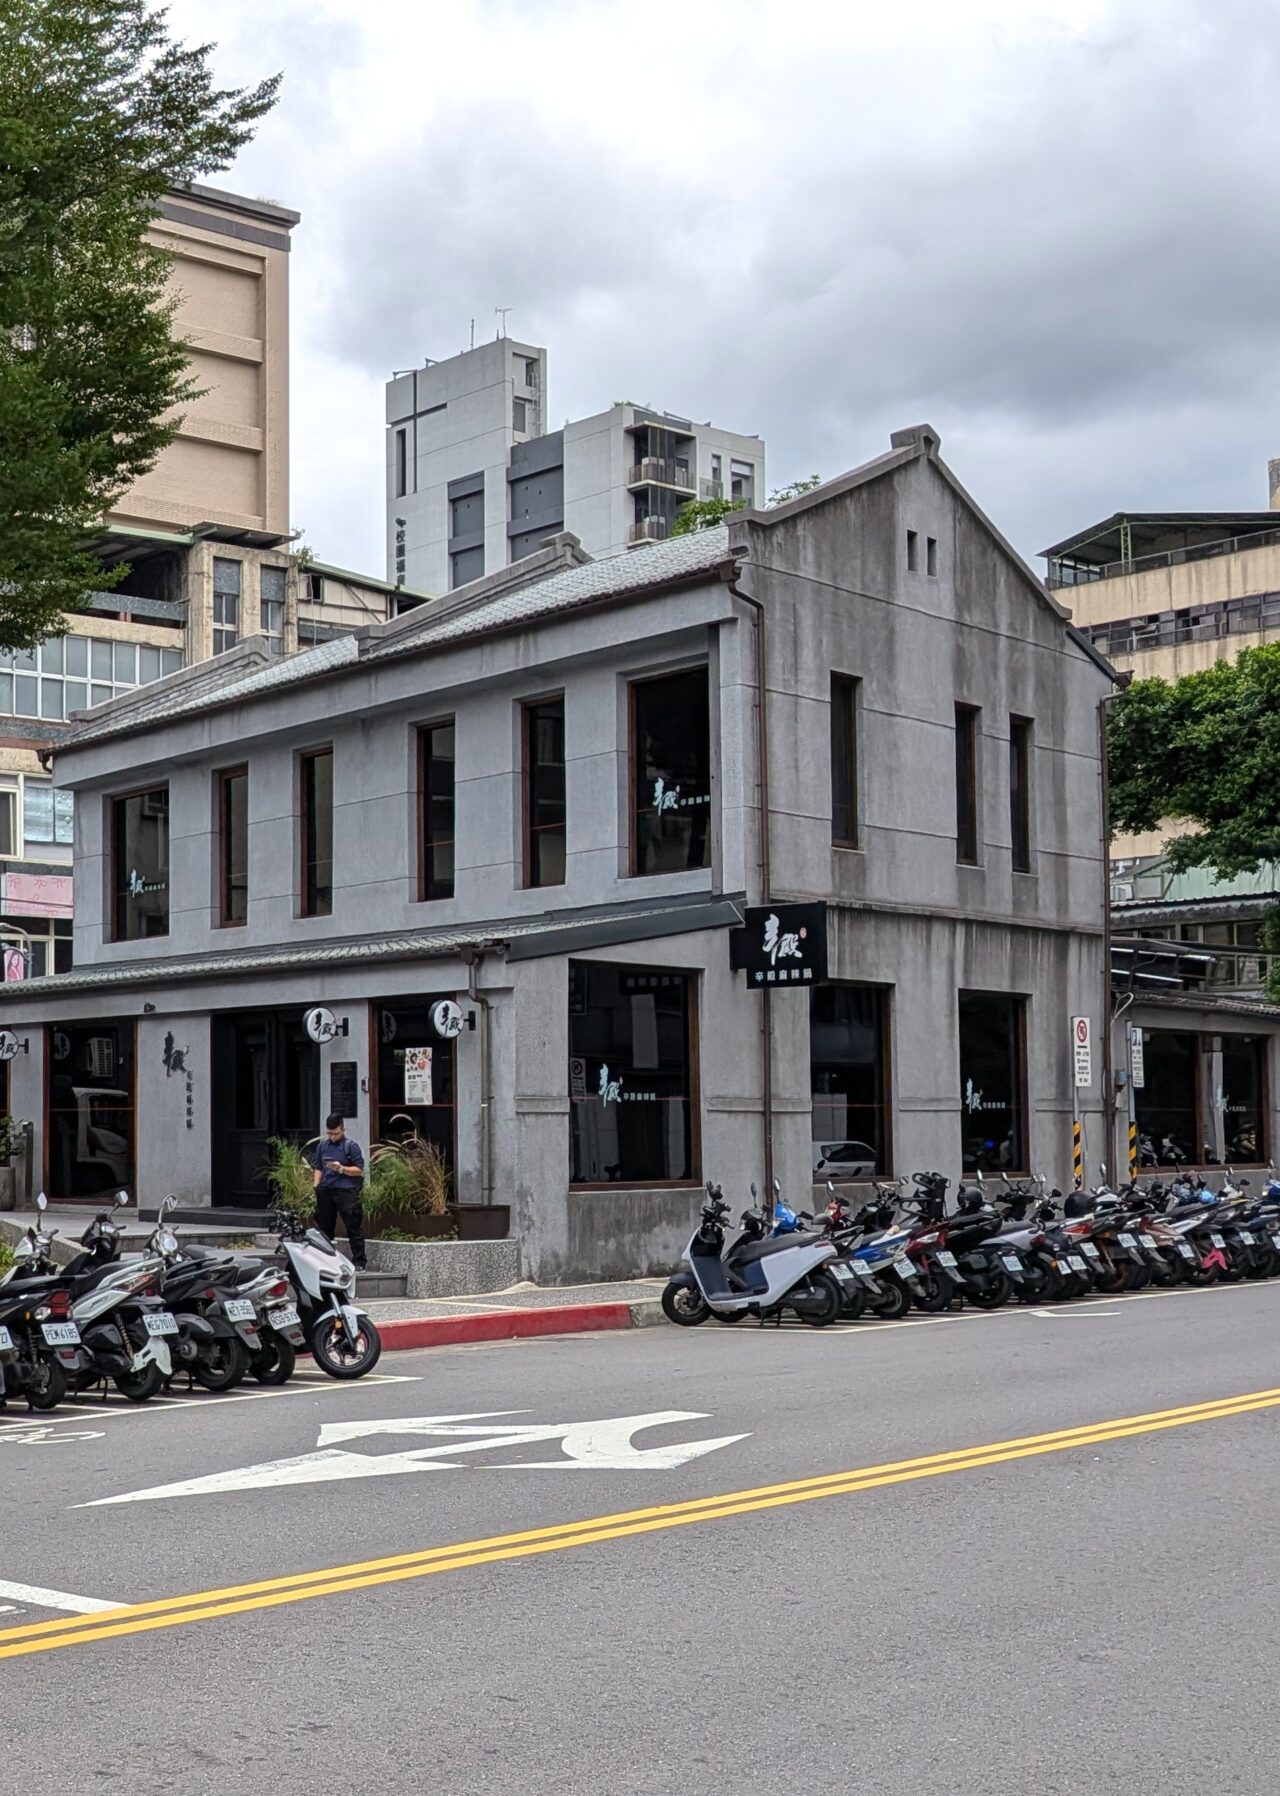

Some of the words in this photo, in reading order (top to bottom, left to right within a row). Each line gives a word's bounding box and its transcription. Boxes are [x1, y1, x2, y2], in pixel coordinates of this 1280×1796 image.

[754, 968, 813, 982] 辛殿麻辣鍋
